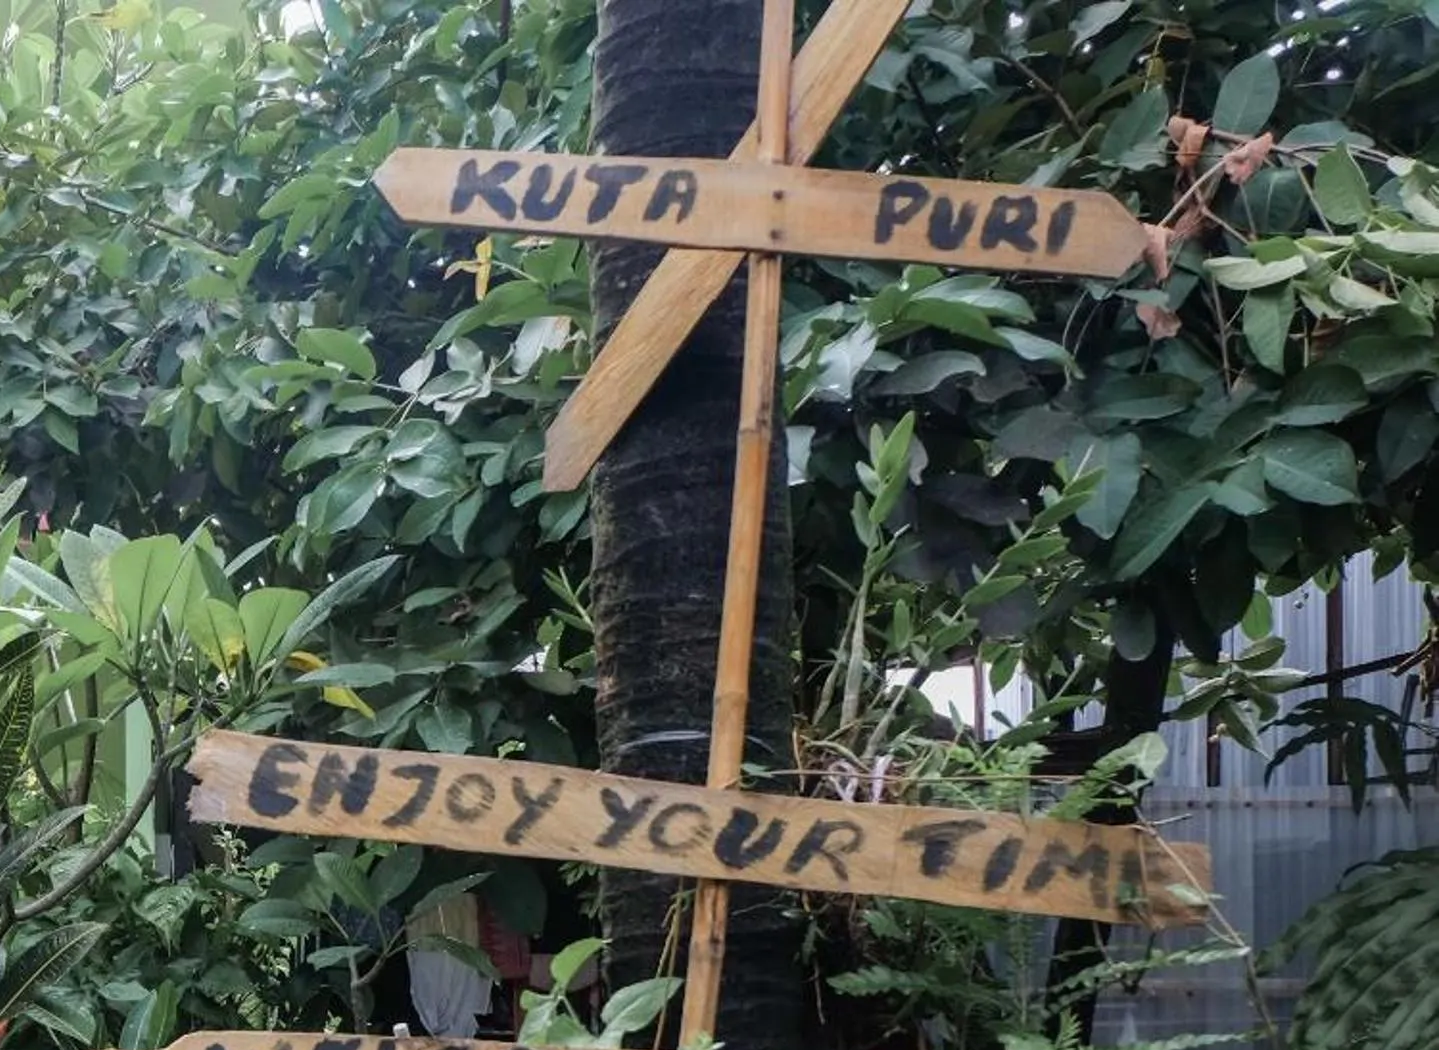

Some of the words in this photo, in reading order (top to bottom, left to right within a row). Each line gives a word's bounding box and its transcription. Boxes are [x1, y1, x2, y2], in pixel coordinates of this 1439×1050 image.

[448, 157, 700, 225] KUTA
[872, 180, 1077, 255] PURI
[247, 742, 566, 846] ENJOY
[594, 785, 866, 882] YOUR
